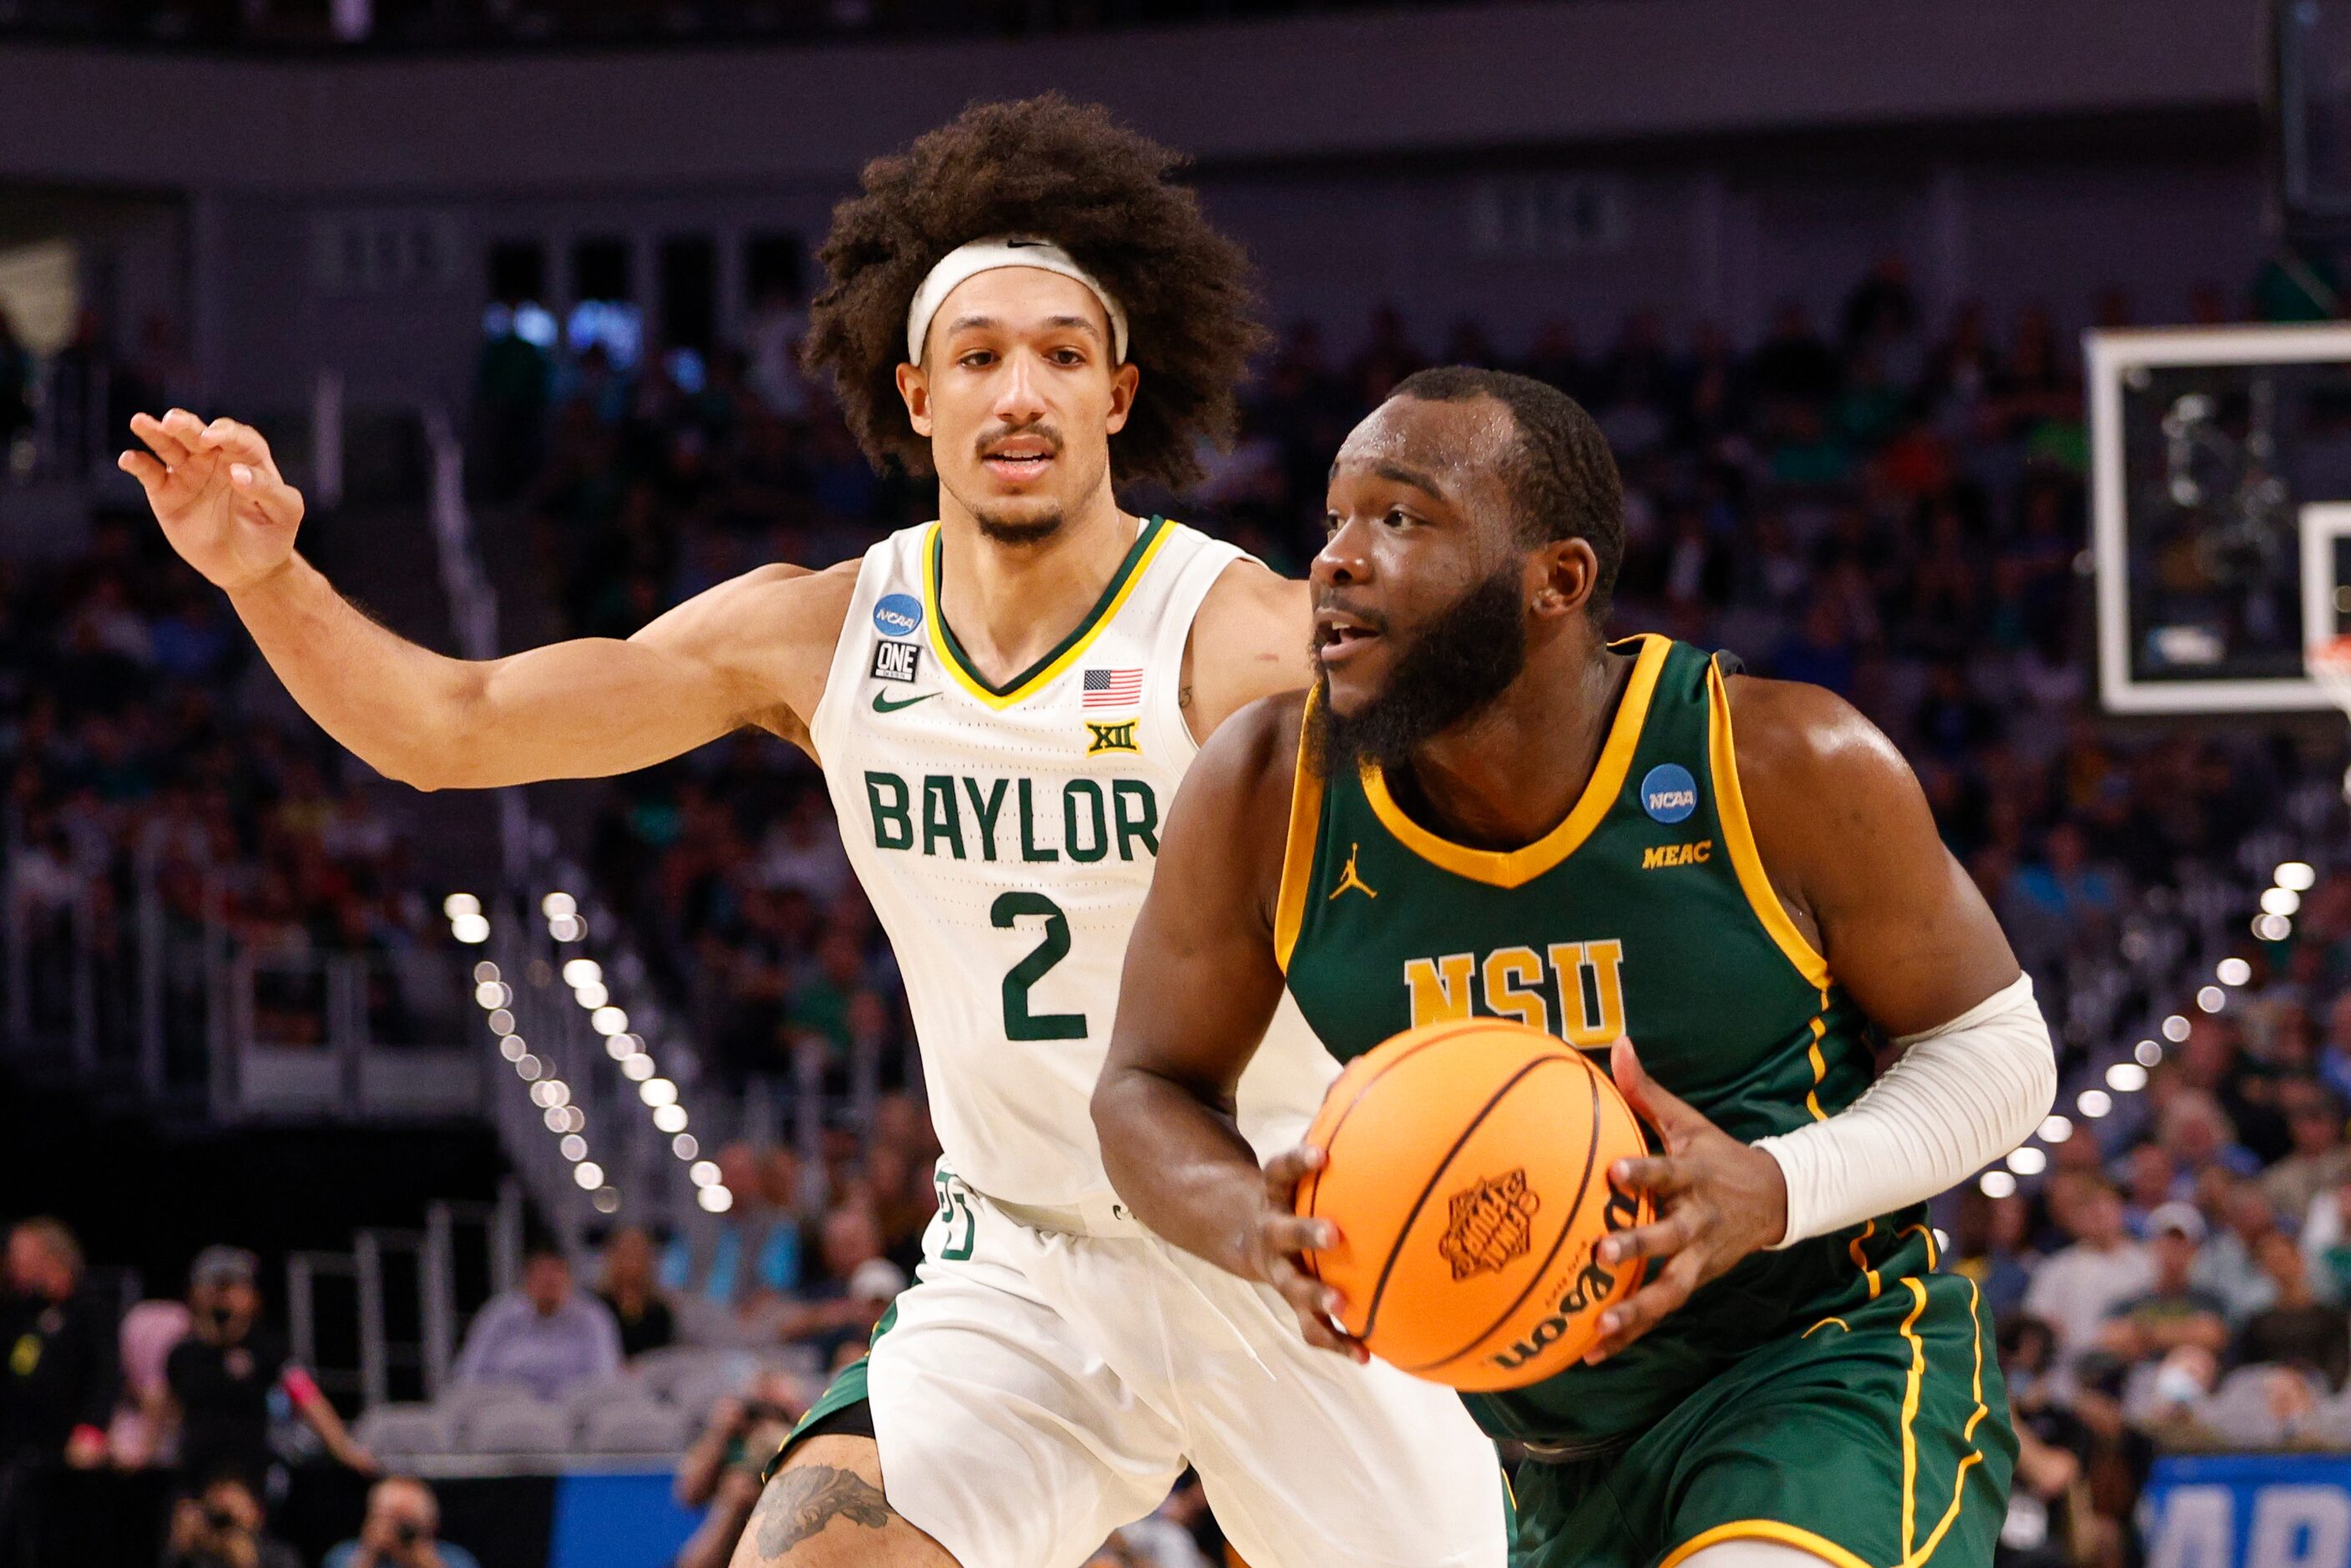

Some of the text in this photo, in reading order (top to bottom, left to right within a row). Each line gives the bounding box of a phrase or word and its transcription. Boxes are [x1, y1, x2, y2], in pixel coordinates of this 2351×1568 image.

[876, 608, 916, 630] NCAA
[877, 642, 918, 673] ONE
[1086, 721, 1137, 752] XII
[1649, 790, 1694, 810] NCAA
[864, 770, 1159, 862] BAYLOR
[1641, 839, 1712, 870] MEAC
[990, 891, 1089, 1040] 2
[1404, 938, 1626, 1050] NSU
